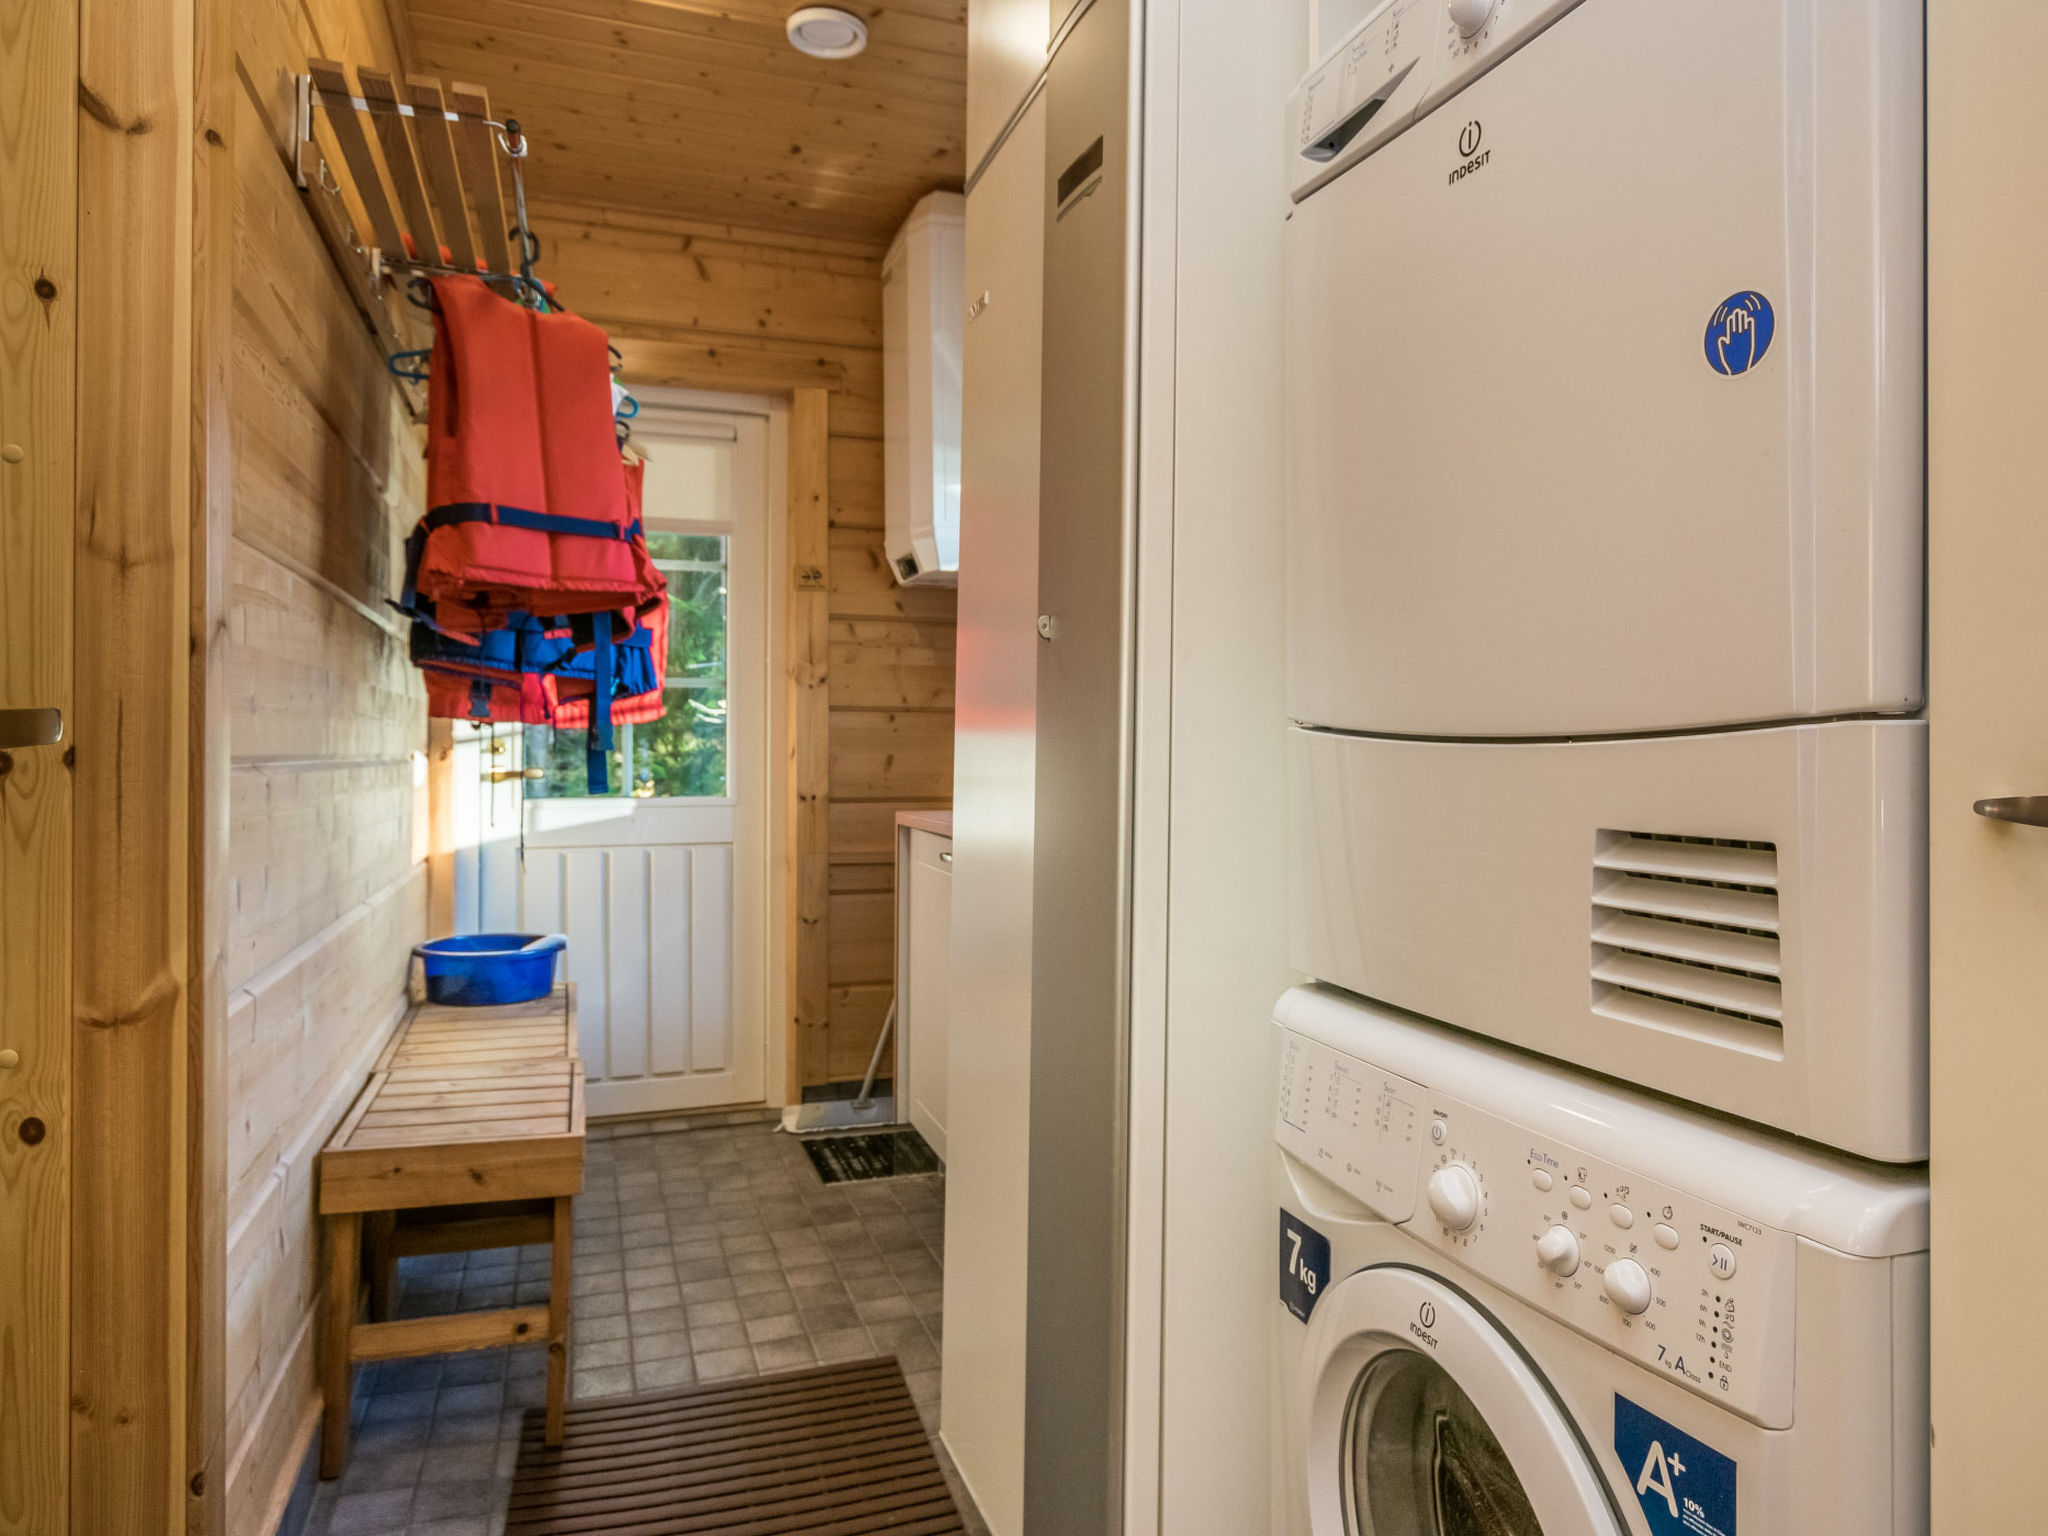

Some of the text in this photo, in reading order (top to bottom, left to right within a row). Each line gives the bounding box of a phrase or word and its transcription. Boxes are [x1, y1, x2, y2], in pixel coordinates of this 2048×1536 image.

[1529, 1147, 1559, 1169] Eco Time
[1699, 1223, 1743, 1247] START/PAUSE
[1604, 1244, 1617, 1255] 1200
[1286, 1228, 1317, 1296] 7 kg
[1650, 1266, 1661, 1277] 400
[1655, 1297, 1667, 1308] 500
[1645, 1320, 1656, 1331] 600
[1695, 1332, 1706, 1343] 12h
[1657, 1344, 1666, 1361] 7
[1674, 1355, 1686, 1375] A
[1685, 1369, 1702, 1384] Class
[1719, 1360, 1732, 1373] END
[1636, 1440, 1687, 1518] A+
[1682, 1497, 1706, 1519] 10%
